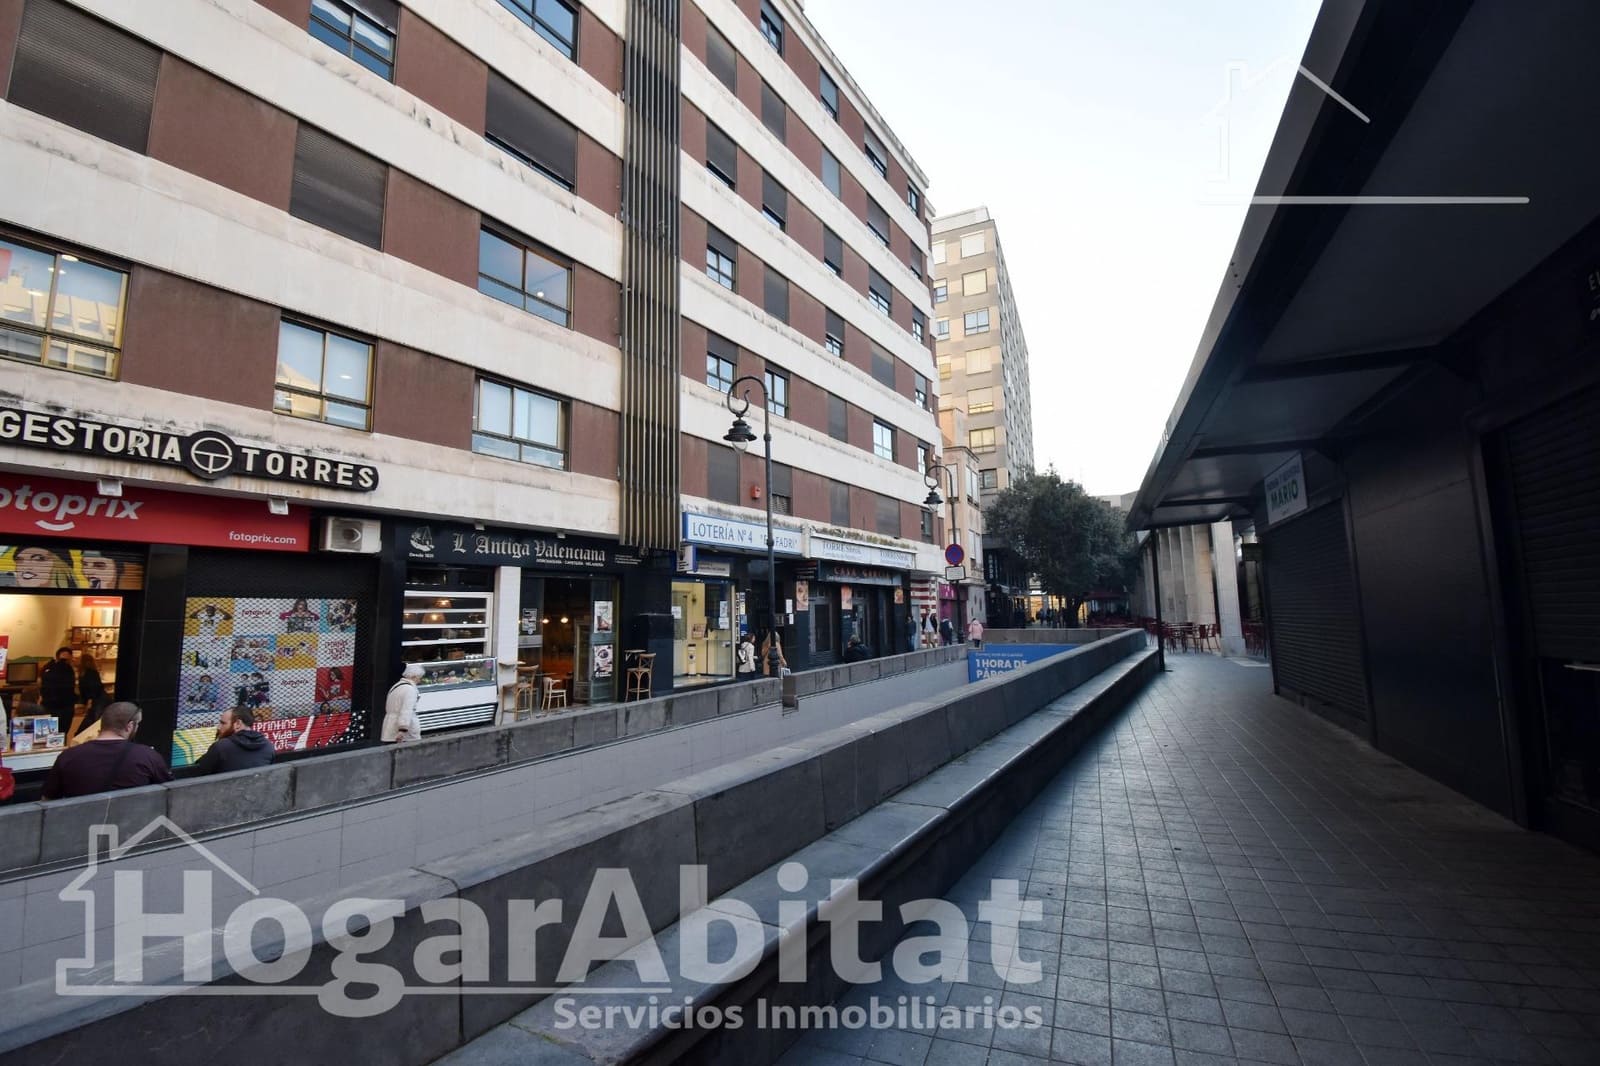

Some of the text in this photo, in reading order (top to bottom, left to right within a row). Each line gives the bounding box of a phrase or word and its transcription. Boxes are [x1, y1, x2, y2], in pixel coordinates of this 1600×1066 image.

[0, 410, 376, 489] GESTORIA TORRES
[1270, 479, 1298, 508] MARIO
[229, 531, 297, 545] fotoprix.com
[693, 522, 735, 542] LOTERÍA
[748, 532, 753, 544] 4
[534, 540, 606, 563] Valenciana
[982, 659, 1012, 668] HORA
